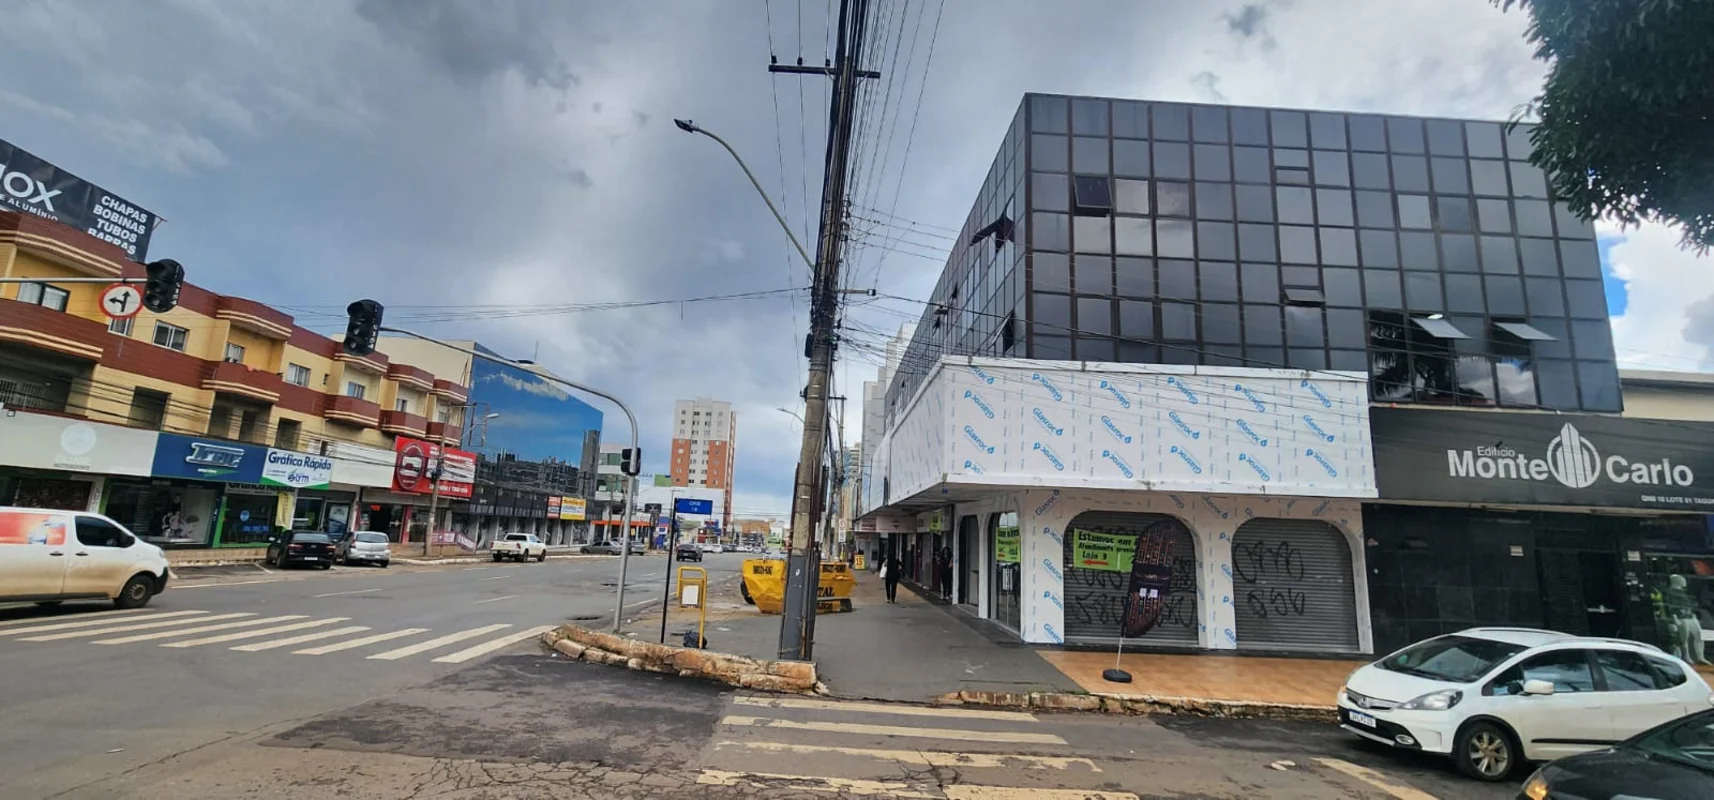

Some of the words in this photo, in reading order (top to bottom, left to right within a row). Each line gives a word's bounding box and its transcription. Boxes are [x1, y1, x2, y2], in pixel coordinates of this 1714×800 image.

[0, 164, 62, 212] OX
[93, 204, 146, 235] BOBINAS
[101, 195, 148, 223] CHAPAS
[97, 218, 138, 243] TUBOS
[972, 395, 995, 420] Glasroc
[1108, 385, 1131, 409] Glasroc
[1242, 387, 1266, 413] Glasroc
[1308, 383, 1332, 408] Glasroc
[1033, 407, 1057, 433] Glasroc
[1101, 415, 1125, 440] Glasroc
[1168, 411, 1193, 435] Glasroc
[1236, 418, 1260, 442] Glasroc
[1303, 414, 1328, 439] Glasroc
[964, 425, 988, 451] Glasroc
[268, 451, 303, 467] Gráfica
[304, 456, 332, 471] Rápida
[1041, 446, 1065, 472] Glasroc
[1110, 453, 1134, 479] Glasroc
[1177, 448, 1202, 475] Glasroc
[1247, 456, 1270, 482] Glasroc
[1313, 452, 1338, 478] Glasroc
[1447, 449, 1549, 480] Monte
[1606, 455, 1693, 486] Carlo
